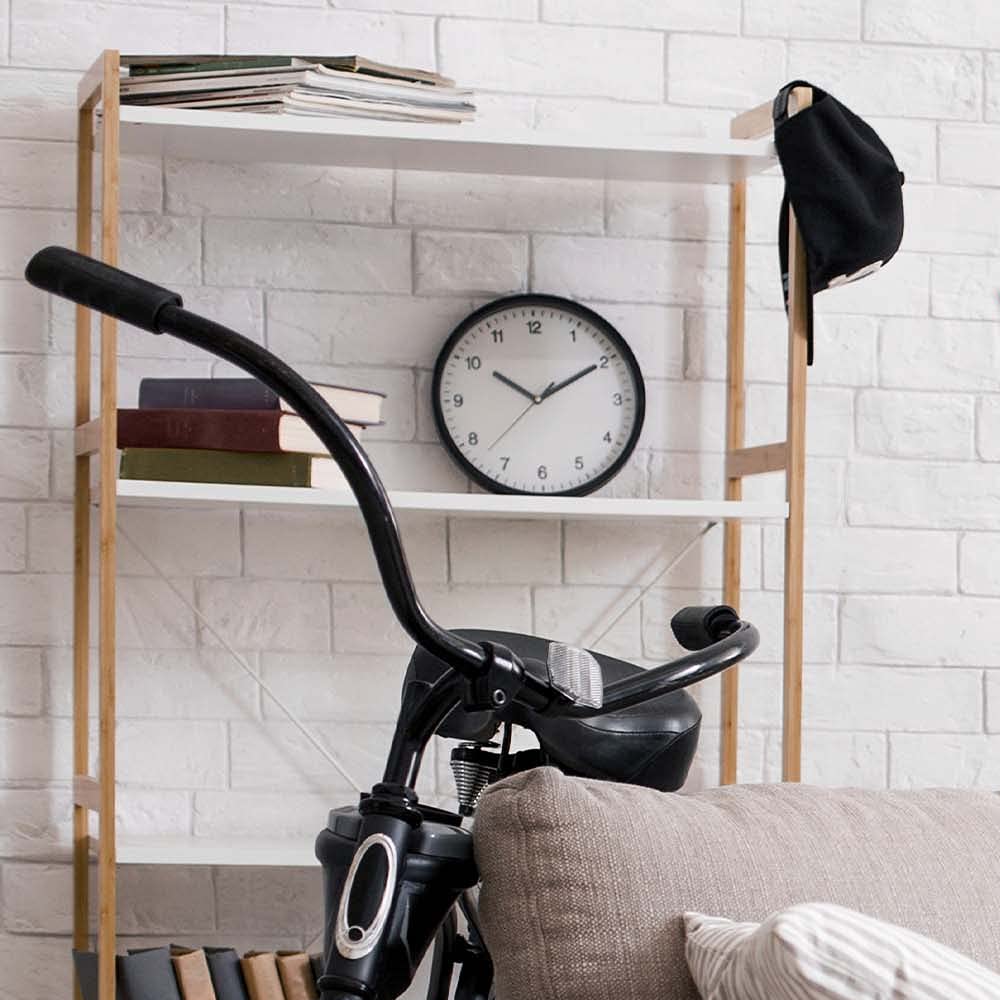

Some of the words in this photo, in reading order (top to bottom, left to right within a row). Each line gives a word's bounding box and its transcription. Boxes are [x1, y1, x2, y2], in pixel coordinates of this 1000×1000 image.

[526, 320, 542, 335] 12
[491, 329, 504, 343] 11
[570, 330, 577, 342] 1
[465, 356, 482, 370] 10
[600, 355, 609, 369] 2
[453, 394, 464, 408] 9
[613, 393, 623, 406] 3
[467, 432, 479, 446] 8
[602, 431, 612, 444] 4
[500, 456, 510, 471] 7
[574, 456, 584, 470] 5
[537, 465, 548, 480] 6
